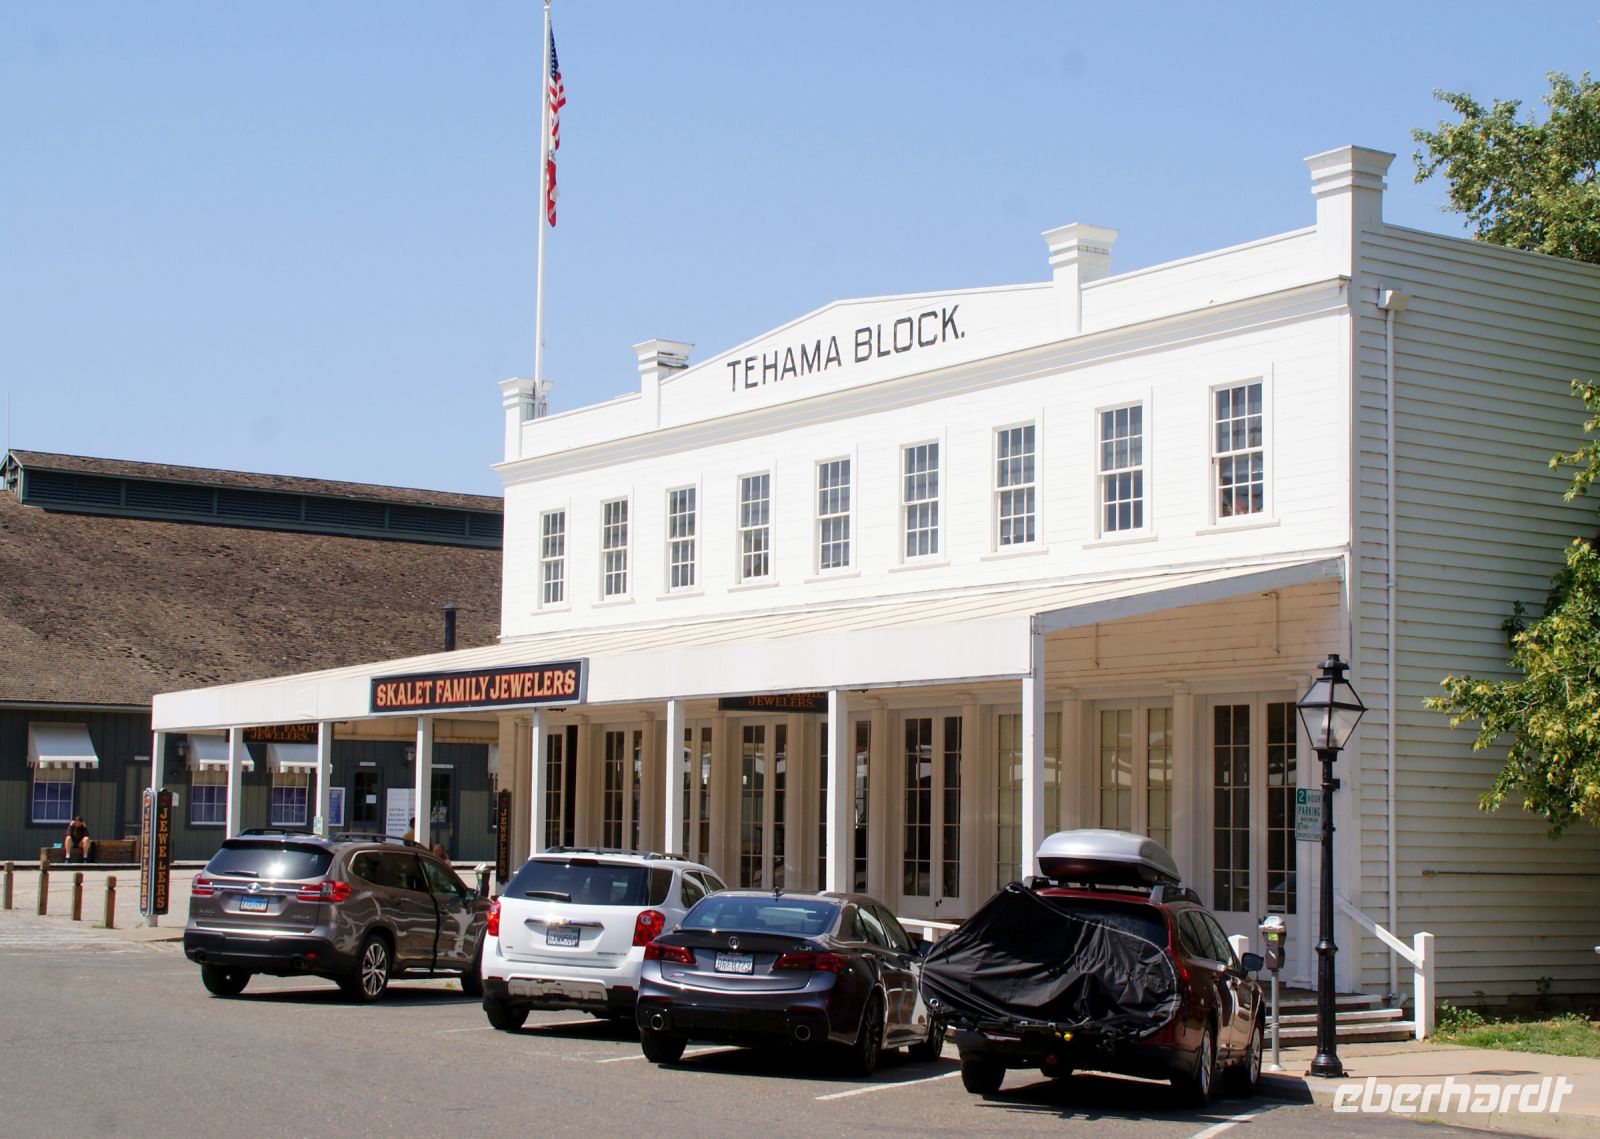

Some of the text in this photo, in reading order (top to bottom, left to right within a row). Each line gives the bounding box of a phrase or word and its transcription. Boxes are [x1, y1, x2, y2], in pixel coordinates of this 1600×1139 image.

[726, 304, 965, 392] TEHAMA BLOCK.
[376, 669, 576, 707] SKALET FAMILY JEWELERS
[1298, 790, 1305, 803] 2
[1298, 806, 1321, 817] PARKING
[141, 807, 151, 909] JEWELERS
[156, 807, 169, 909] JEWELERS
